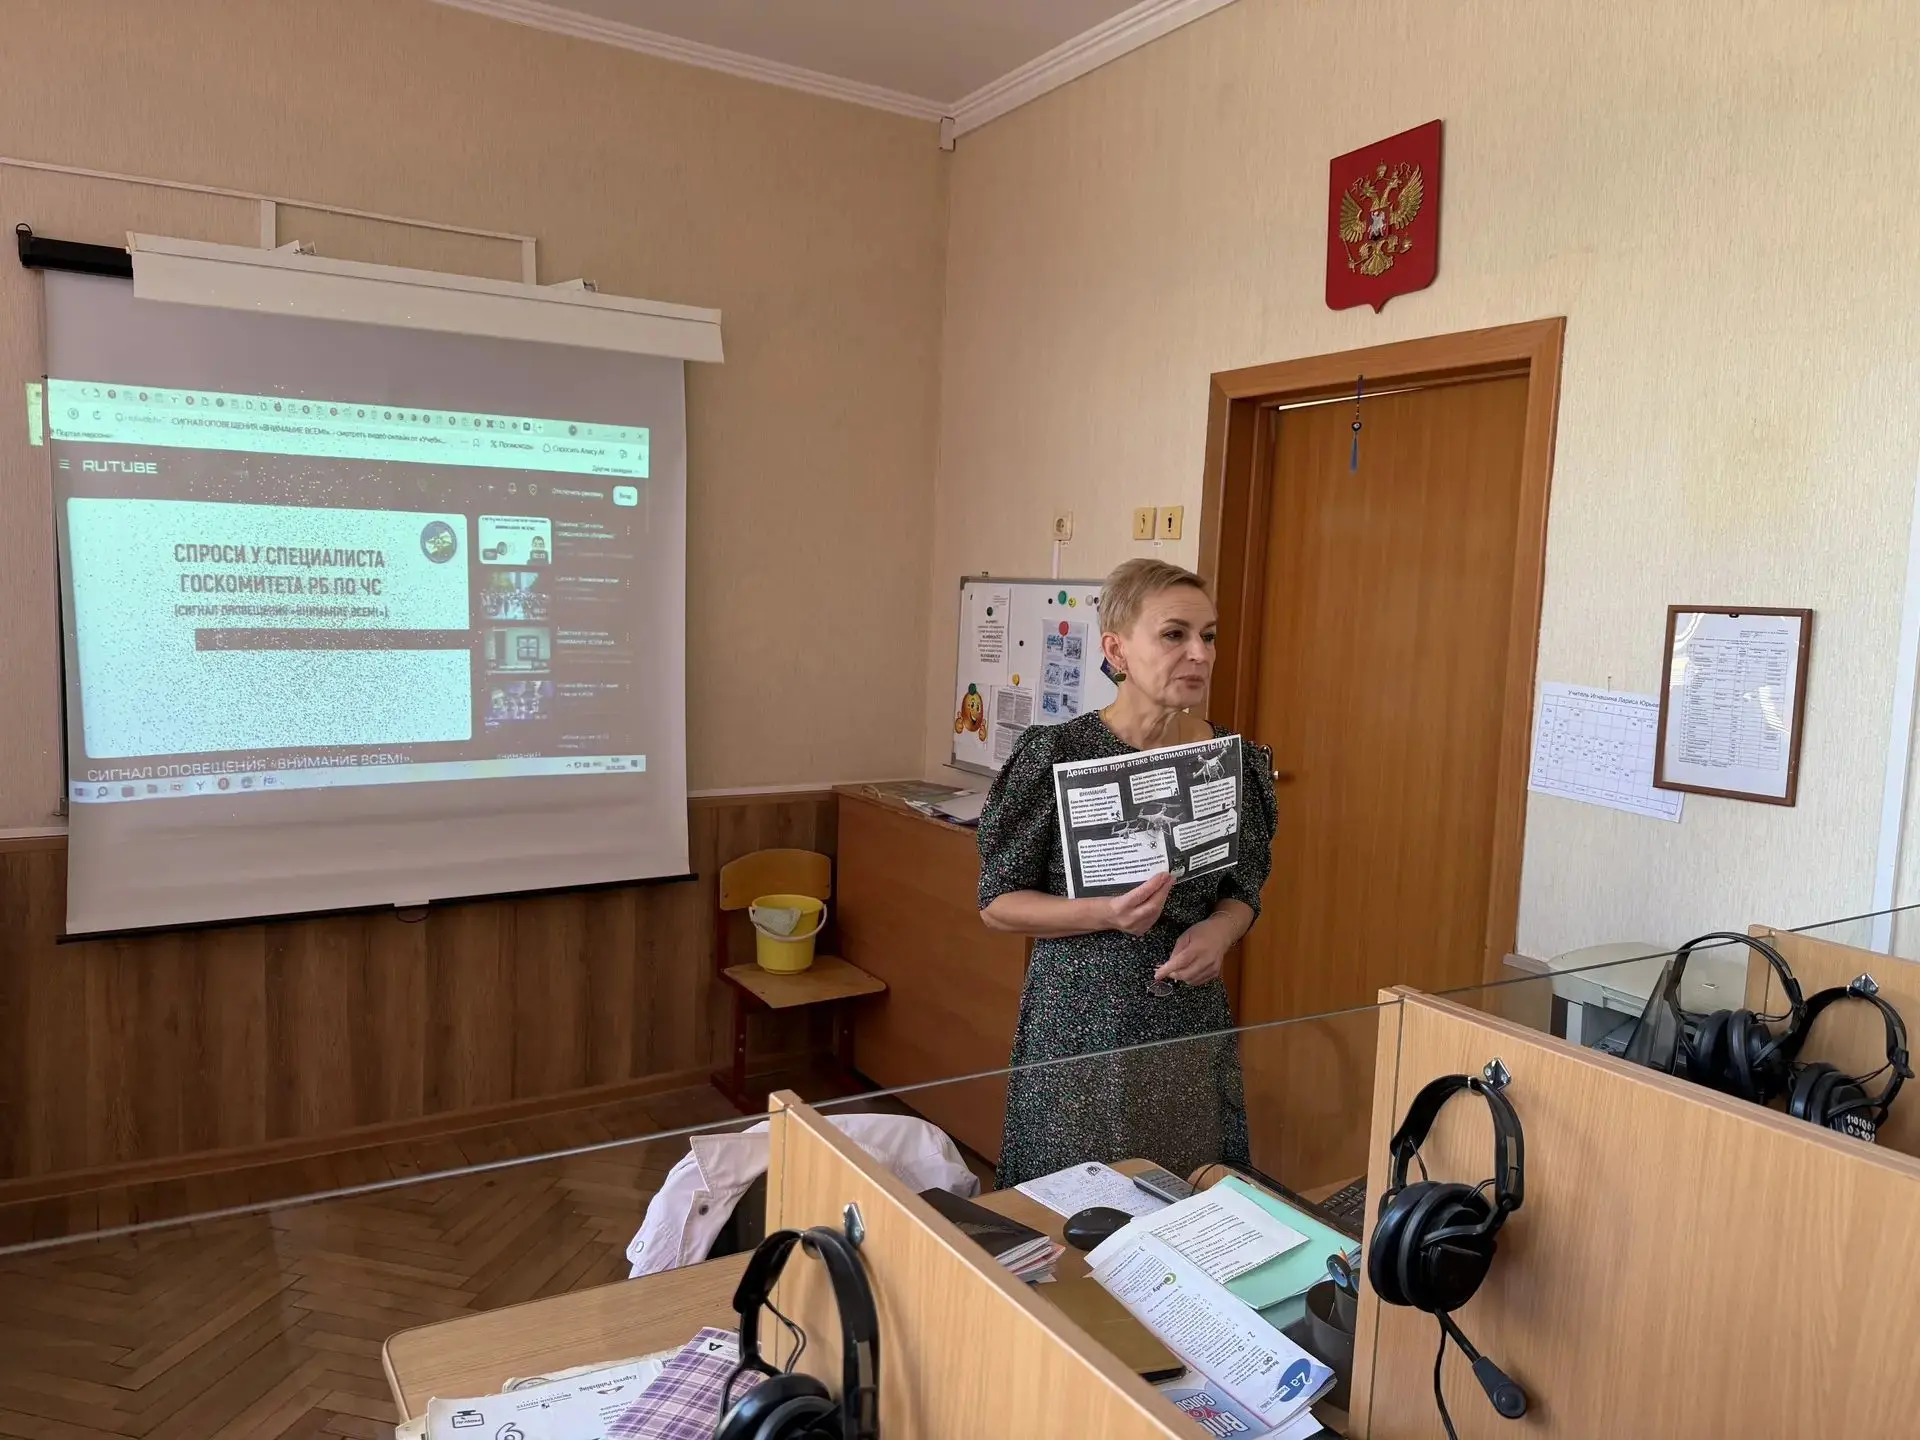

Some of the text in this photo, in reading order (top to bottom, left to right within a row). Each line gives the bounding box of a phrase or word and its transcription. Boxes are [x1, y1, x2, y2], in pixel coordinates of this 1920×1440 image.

[82, 460, 158, 474] RUTUBE
[174, 544, 386, 568] СПРОСИ У СПЕЦИАЛИСТА
[180, 574, 382, 596] ГОСКОМИТЕТА РБ ПО ЧС
[86, 766, 152, 782] СИГНАЛ
[157, 761, 266, 778] ОПОВЕЩЕНИЯ
[271, 754, 358, 770] «ВНИМАНИЕ
[1066, 764, 1108, 778] Действия
[1110, 761, 1126, 773] при
[1127, 756, 1149, 769] атаке
[1150, 747, 1207, 765] беспилотника
[578, 1374, 638, 1392] Express Publishing
[1290, 1372, 1312, 1386] 2a
